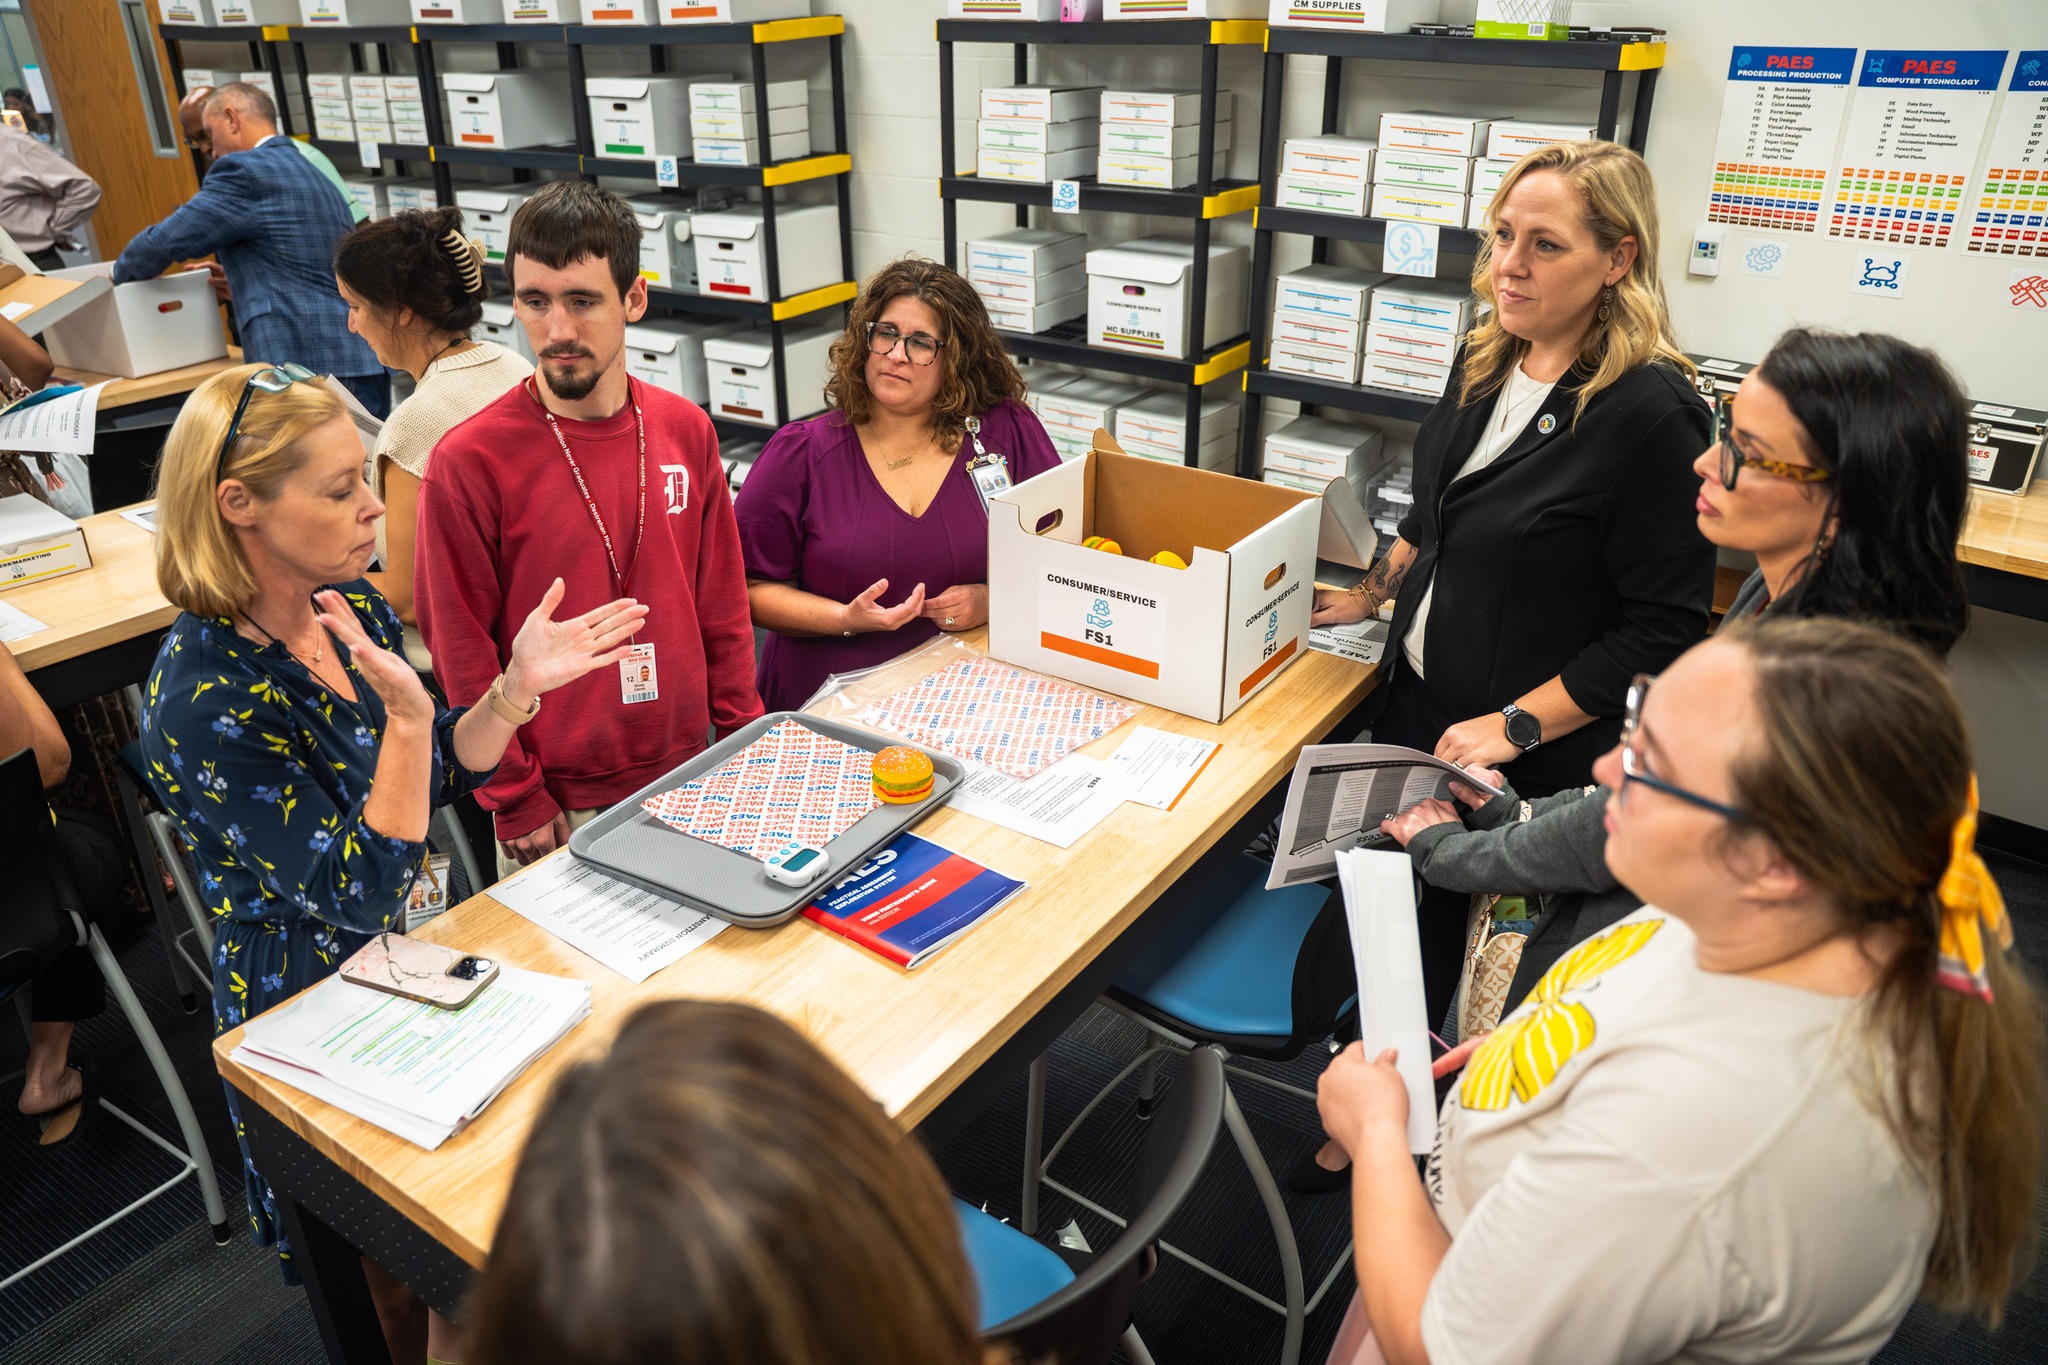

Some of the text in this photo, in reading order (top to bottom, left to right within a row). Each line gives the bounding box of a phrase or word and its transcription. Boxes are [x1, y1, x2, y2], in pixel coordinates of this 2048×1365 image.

[1294, 0, 1362, 10] CM SUPPLIES
[1766, 55, 1815, 69] PAES
[1902, 59, 1957, 75] PAES
[1737, 69, 1842, 80] PROCESSING PRODUCTION
[1876, 77, 1980, 86] COMPUTER TECHNOLOGY
[1785, 94, 1811, 102] Assembly
[1106, 301, 1162, 313] CONSUMER/SERVICE
[1120, 327, 1160, 339] SUPPLIES
[1968, 449, 1991, 459] AES
[551, 421, 567, 449] Tradition
[564, 447, 576, 467] Never
[573, 466, 591, 500] Graduates
[589, 503, 607, 535] Destrehan
[603, 534, 612, 551] High
[659, 464, 690, 515] D
[0, 552, 52, 568] ESS/MARKETING
[1047, 573, 1157, 609] CONSUMER/SERVICE
[1245, 581, 1300, 628] CONSUMER/SERVICE
[1085, 628, 1114, 646] FS1
[1309, 630, 1372, 649] towards succ
[1262, 640, 1278, 660] FS1
[1338, 649, 1371, 660] PAES
[966, 702, 977, 716] PAES
[1019, 706, 1029, 720] PAES
[1071, 708, 1081, 724] PAES
[929, 714, 940, 729] PAES
[1000, 733, 1010, 747] PAES
[1029, 750, 1039, 766] PAES
[702, 795, 732, 803] PAES
[661, 814, 692, 823] PAES
[760, 831, 792, 839] PAES
[815, 850, 898, 900] AES
[828, 868, 897, 907] PRACTICAL ASSESSMENT
[834, 875, 897, 910] EXPLORATION SYSTEM
[860, 910, 880, 922] VIDEO
[919, 878, 938, 891] GUIDE
[879, 907, 901, 920] EDITION
[638, 913, 714, 962] ANSITION SUMMARY
